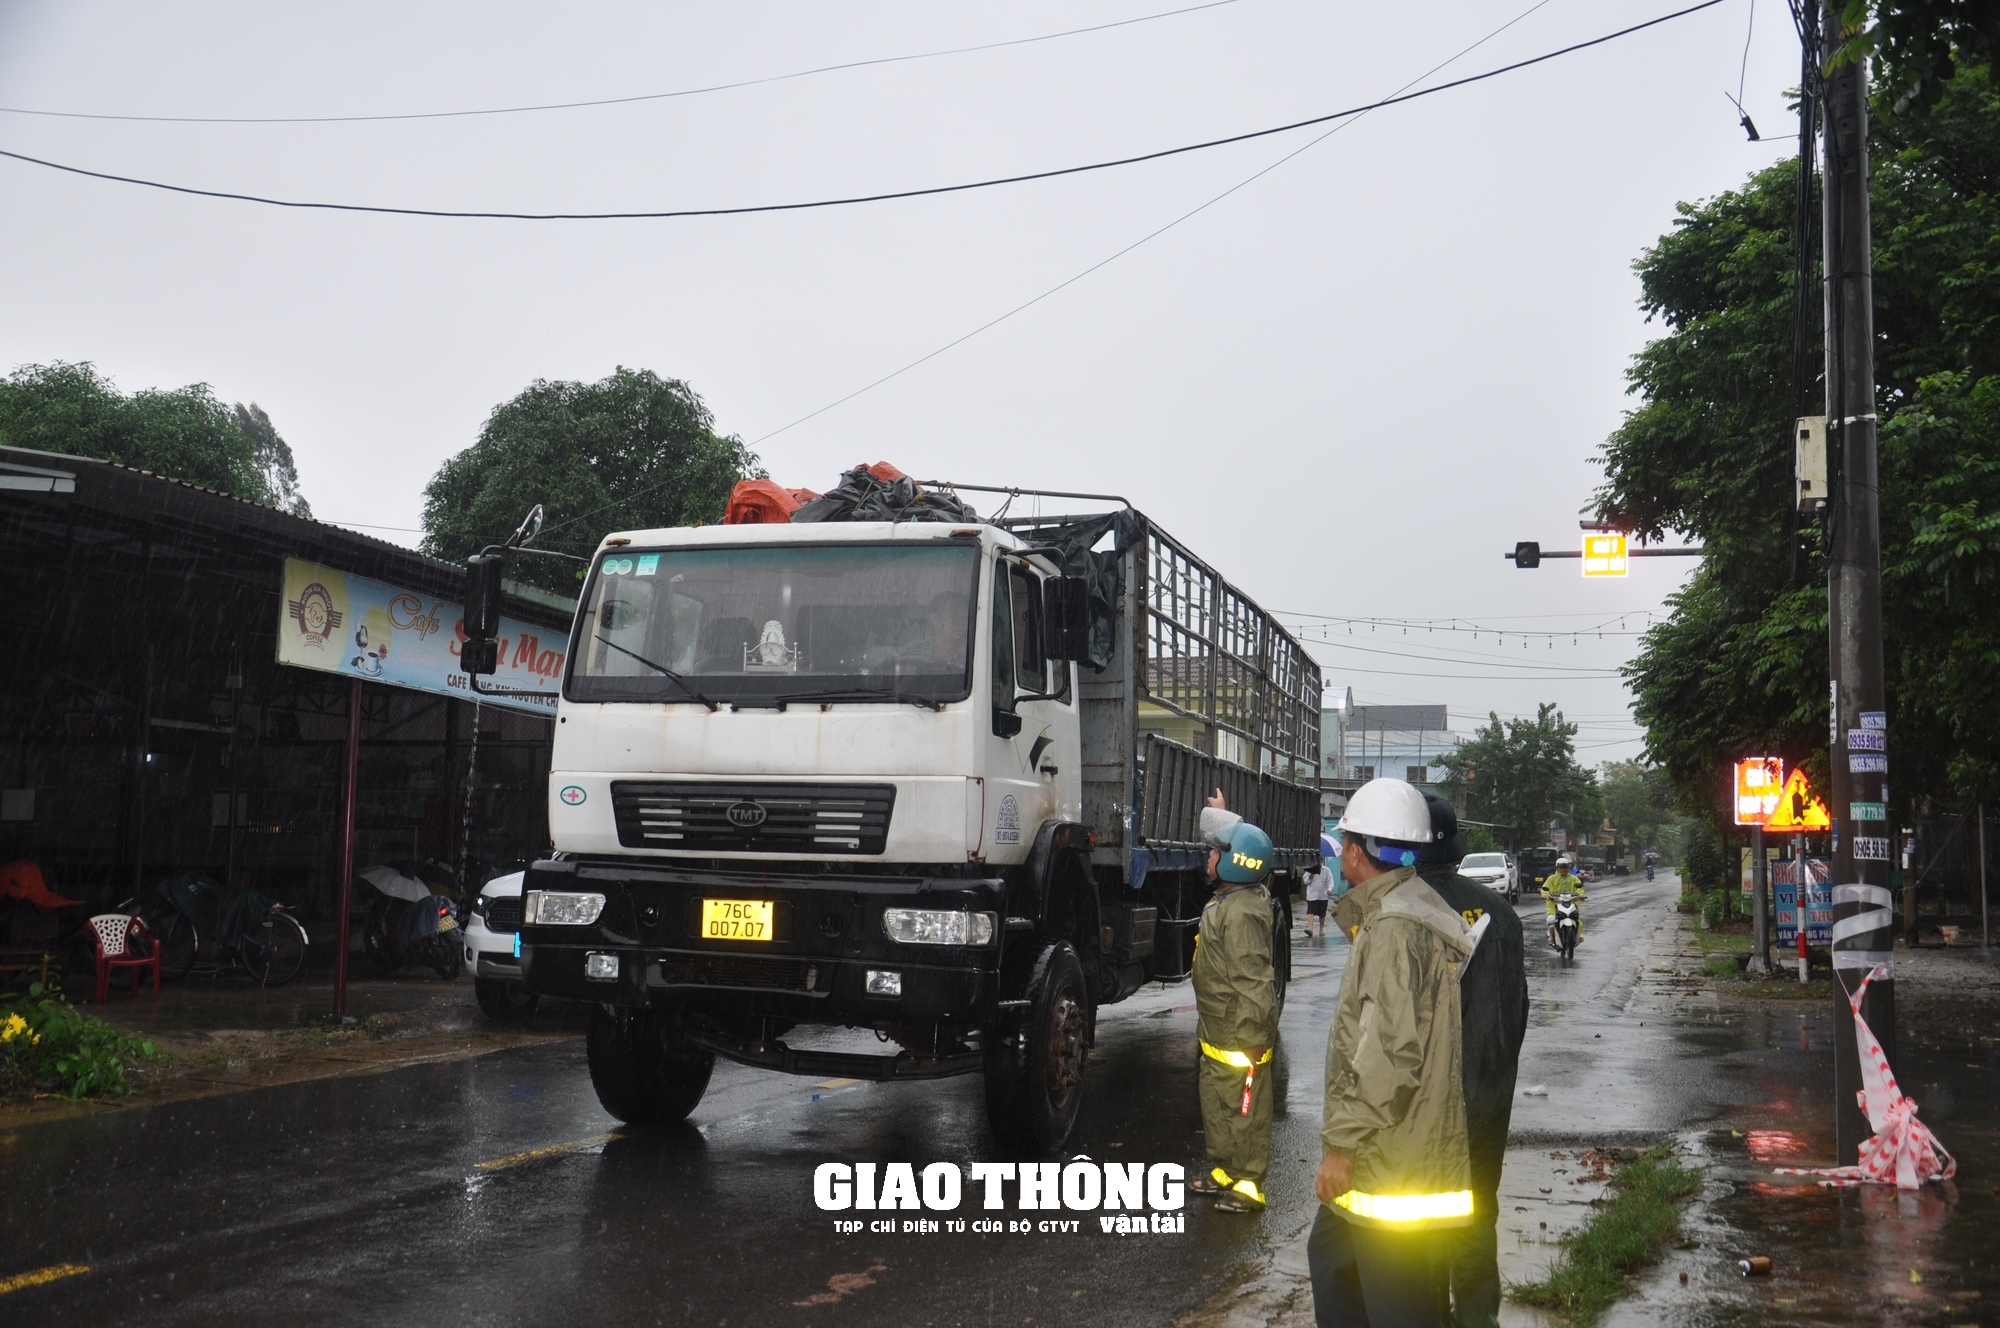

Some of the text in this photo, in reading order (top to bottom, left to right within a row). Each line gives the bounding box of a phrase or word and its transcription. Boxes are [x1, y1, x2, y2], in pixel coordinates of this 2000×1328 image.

[512, 633, 566, 686] Mạn
[731, 809, 762, 820] TMT
[723, 903, 752, 919] 76C
[1778, 912, 1792, 922] IN
[710, 921, 764, 938] 007.07
